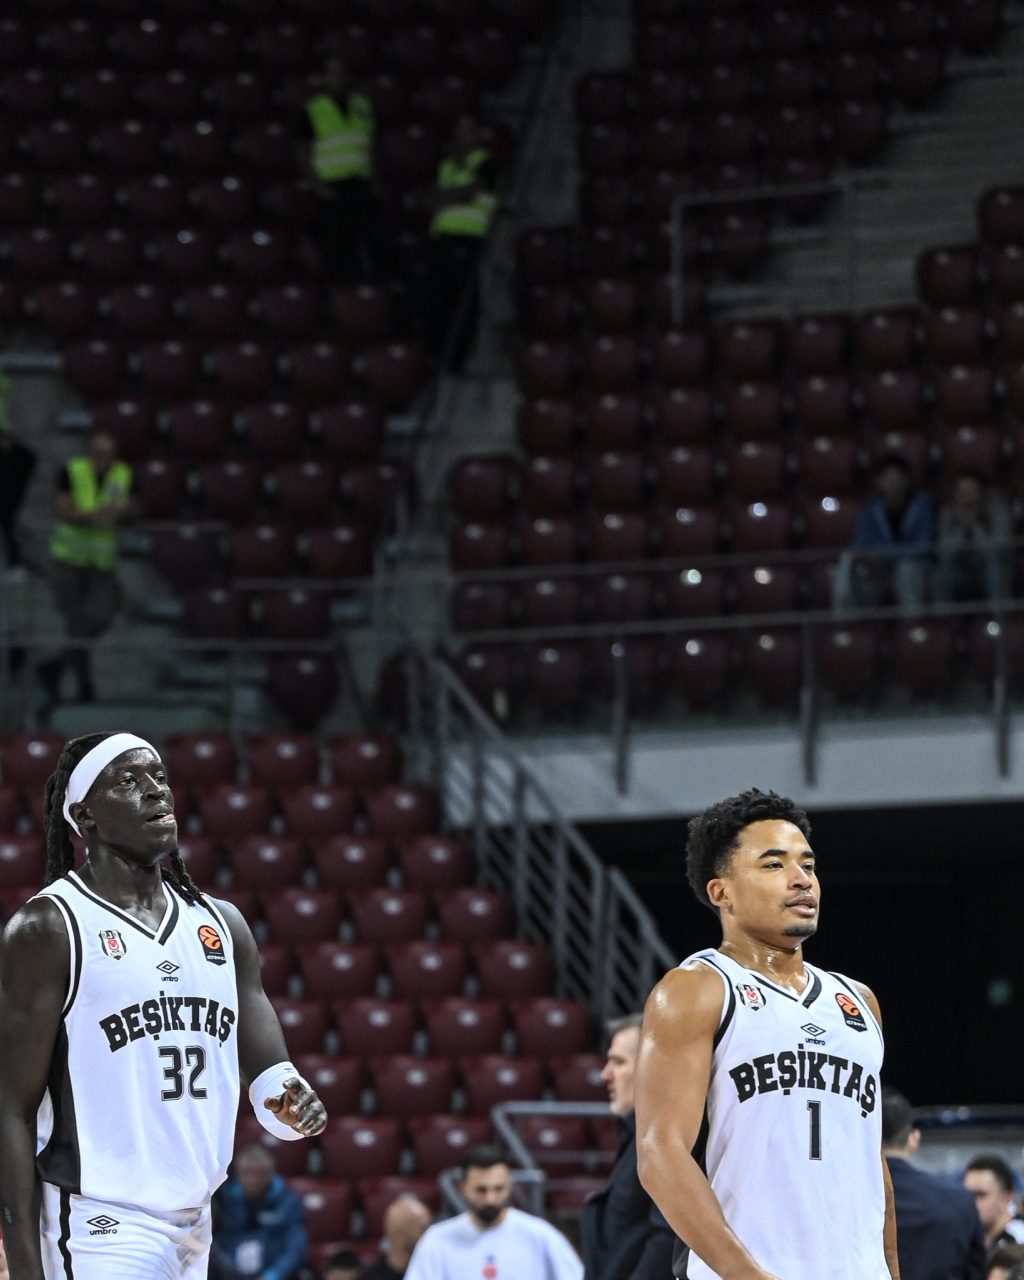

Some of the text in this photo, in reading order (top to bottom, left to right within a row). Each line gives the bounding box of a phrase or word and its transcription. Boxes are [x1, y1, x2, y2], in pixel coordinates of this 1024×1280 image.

[98, 990, 236, 1053] BEŞİKTAŞ
[805, 1037, 826, 1046] umbro
[157, 1045, 208, 1101] 32
[728, 1043, 876, 1119] BEŞİKTAŞ
[806, 1099, 822, 1161] 1
[89, 1228, 118, 1236] umbro
